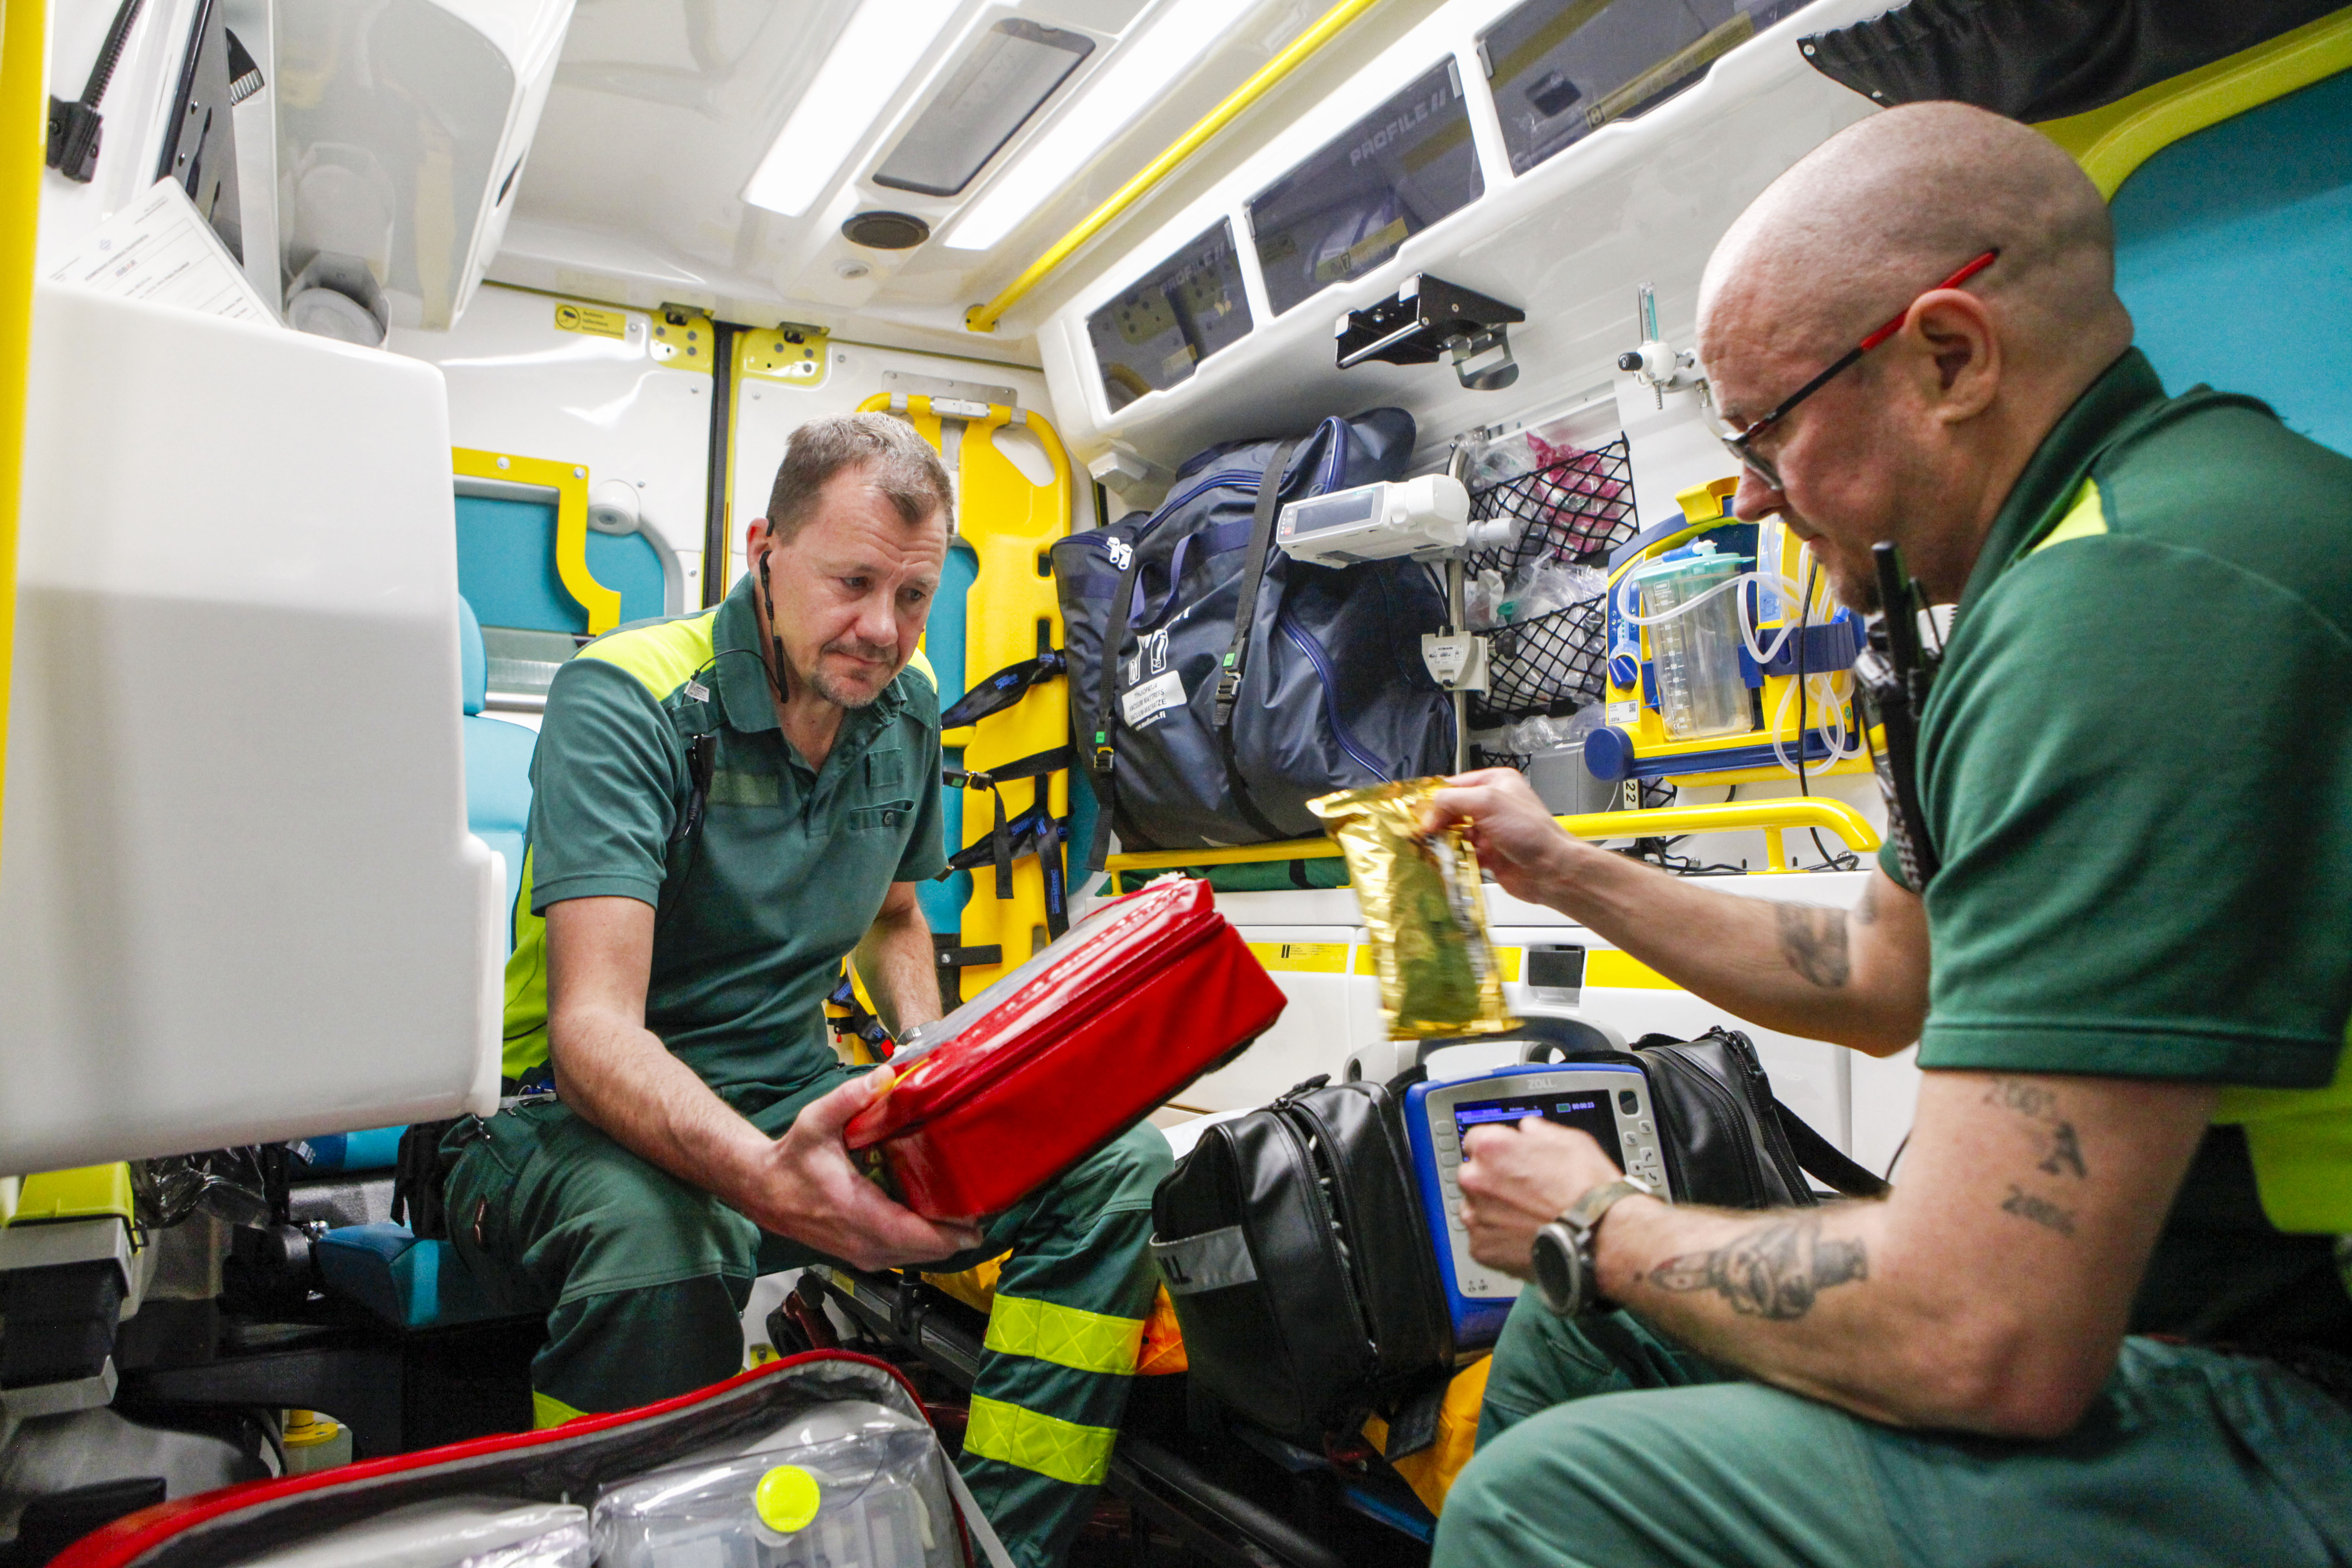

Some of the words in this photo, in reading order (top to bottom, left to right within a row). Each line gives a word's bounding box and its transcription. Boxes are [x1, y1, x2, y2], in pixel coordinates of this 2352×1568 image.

[1349, 101, 1429, 167] PROFILE
[1129, 699, 1143, 712] VACUUM
[1144, 689, 1165, 704] MATTRESS
[1130, 698, 1167, 721] VACUUM-MATRATZE
[1527, 1078, 1555, 1090] ZOLL
